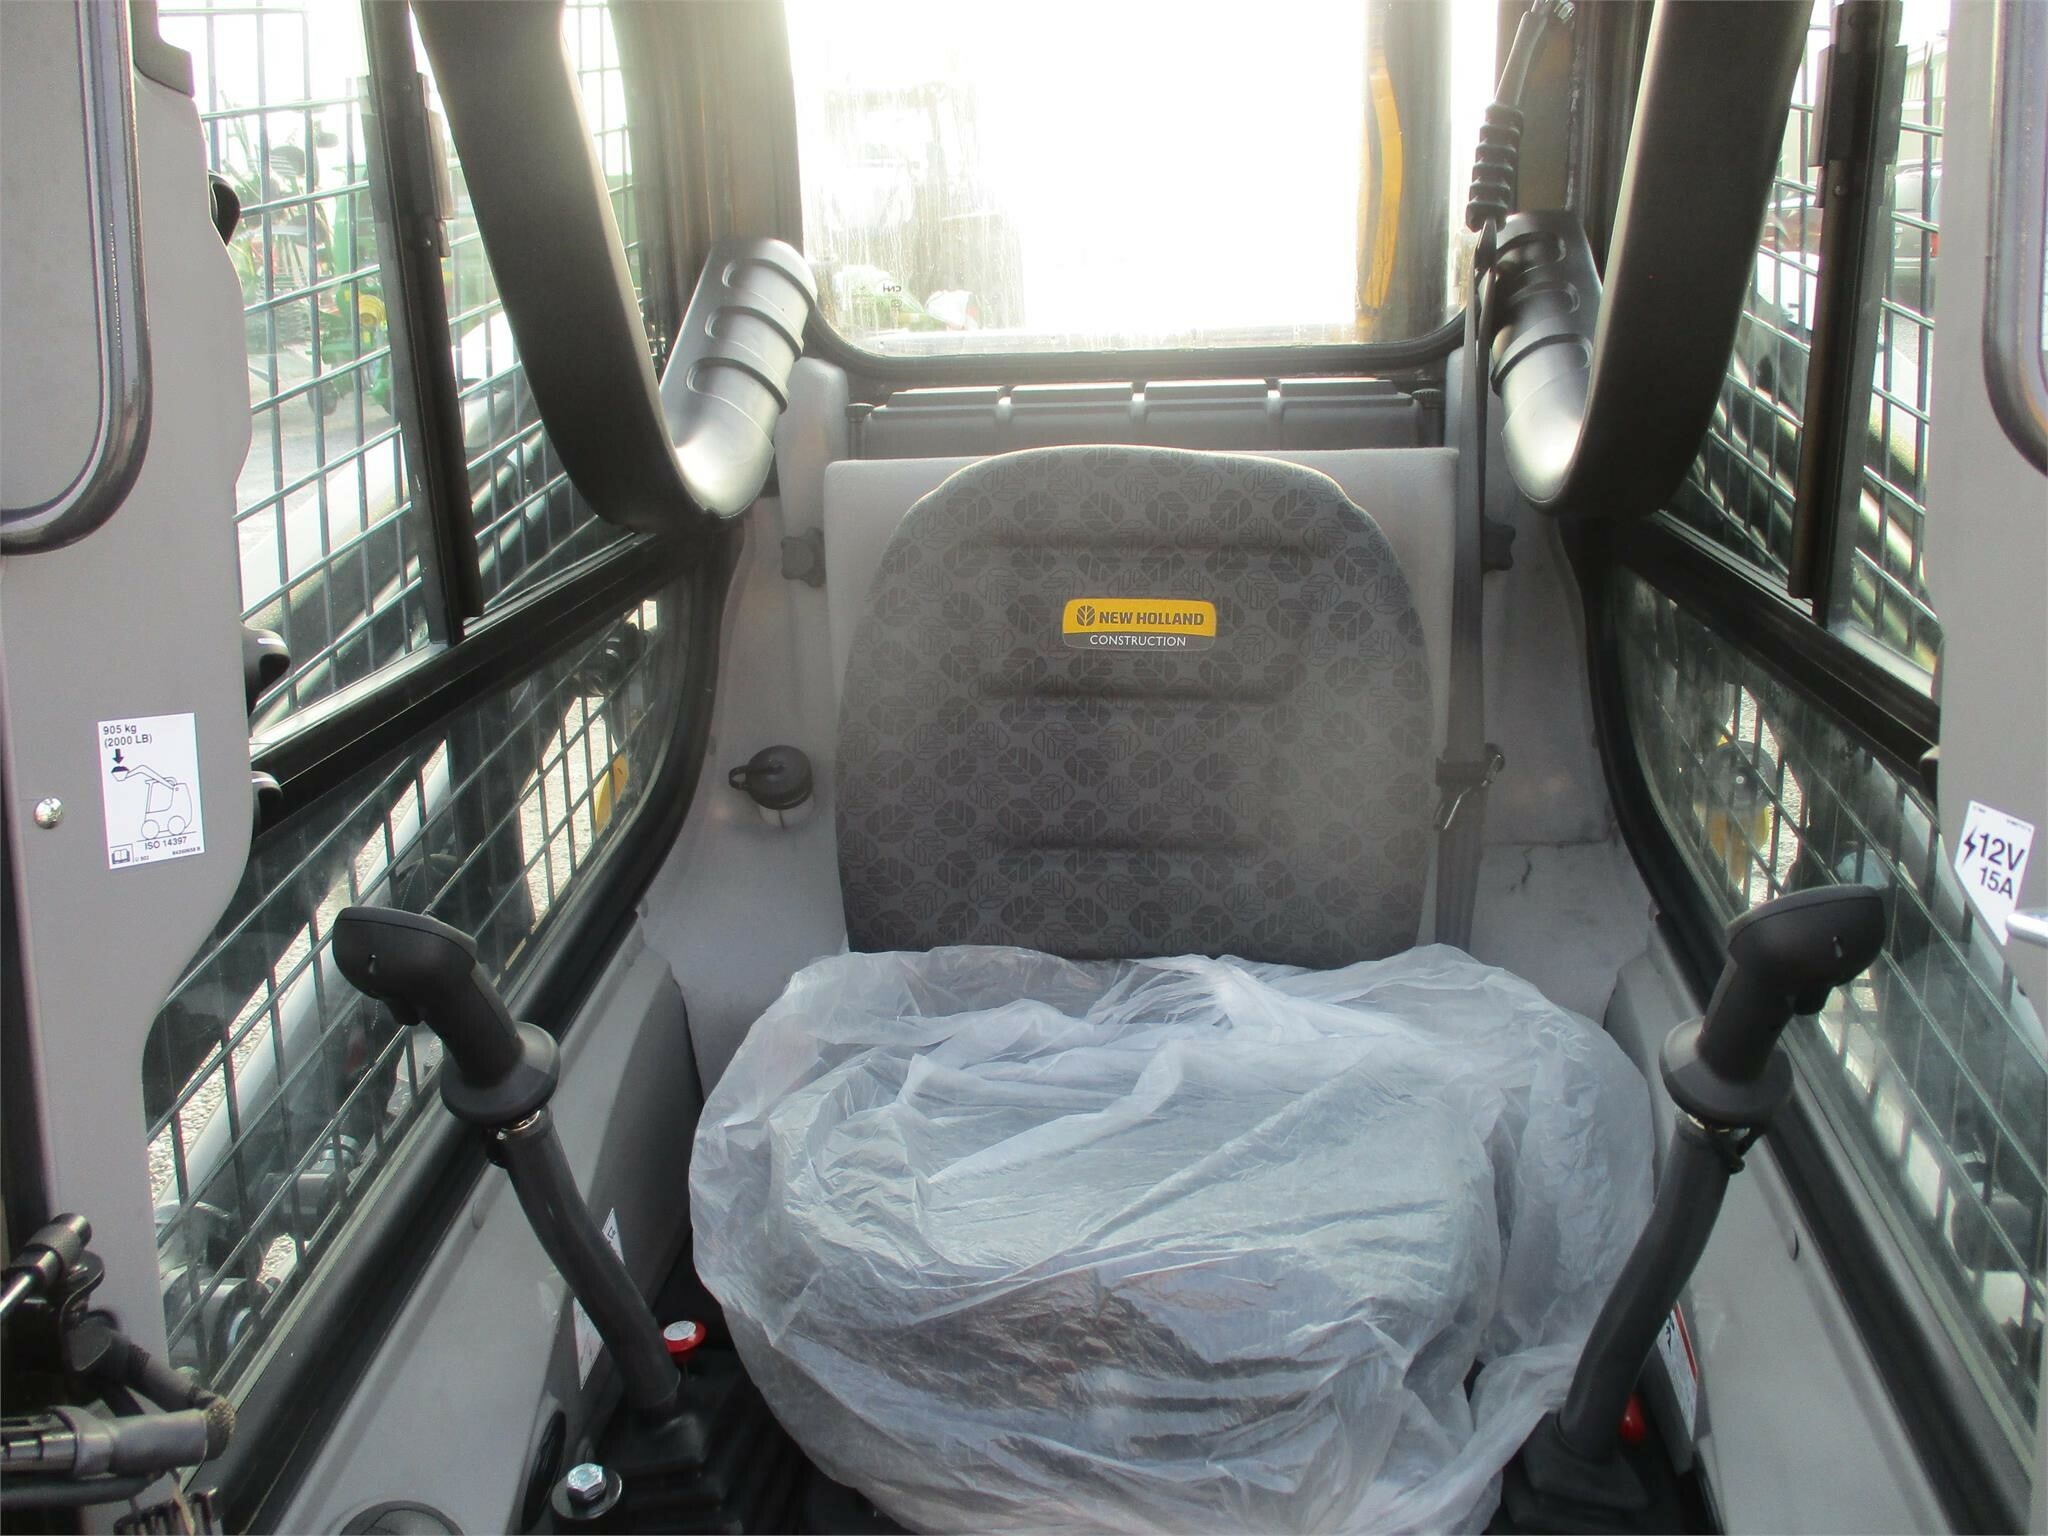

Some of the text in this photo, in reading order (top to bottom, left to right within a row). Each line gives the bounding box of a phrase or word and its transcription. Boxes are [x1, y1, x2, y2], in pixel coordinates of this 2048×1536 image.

[1099, 611, 1205, 626] NEW HOLLAND
[1089, 634, 1187, 647] CONSTRUCTION
[103, 724, 137, 735] 905 kg
[104, 733, 153, 749] (2000 LB)
[144, 836, 188, 850] ISO 14397
[1980, 832, 2026, 871] 12V
[1980, 866, 2013, 900] 15A
